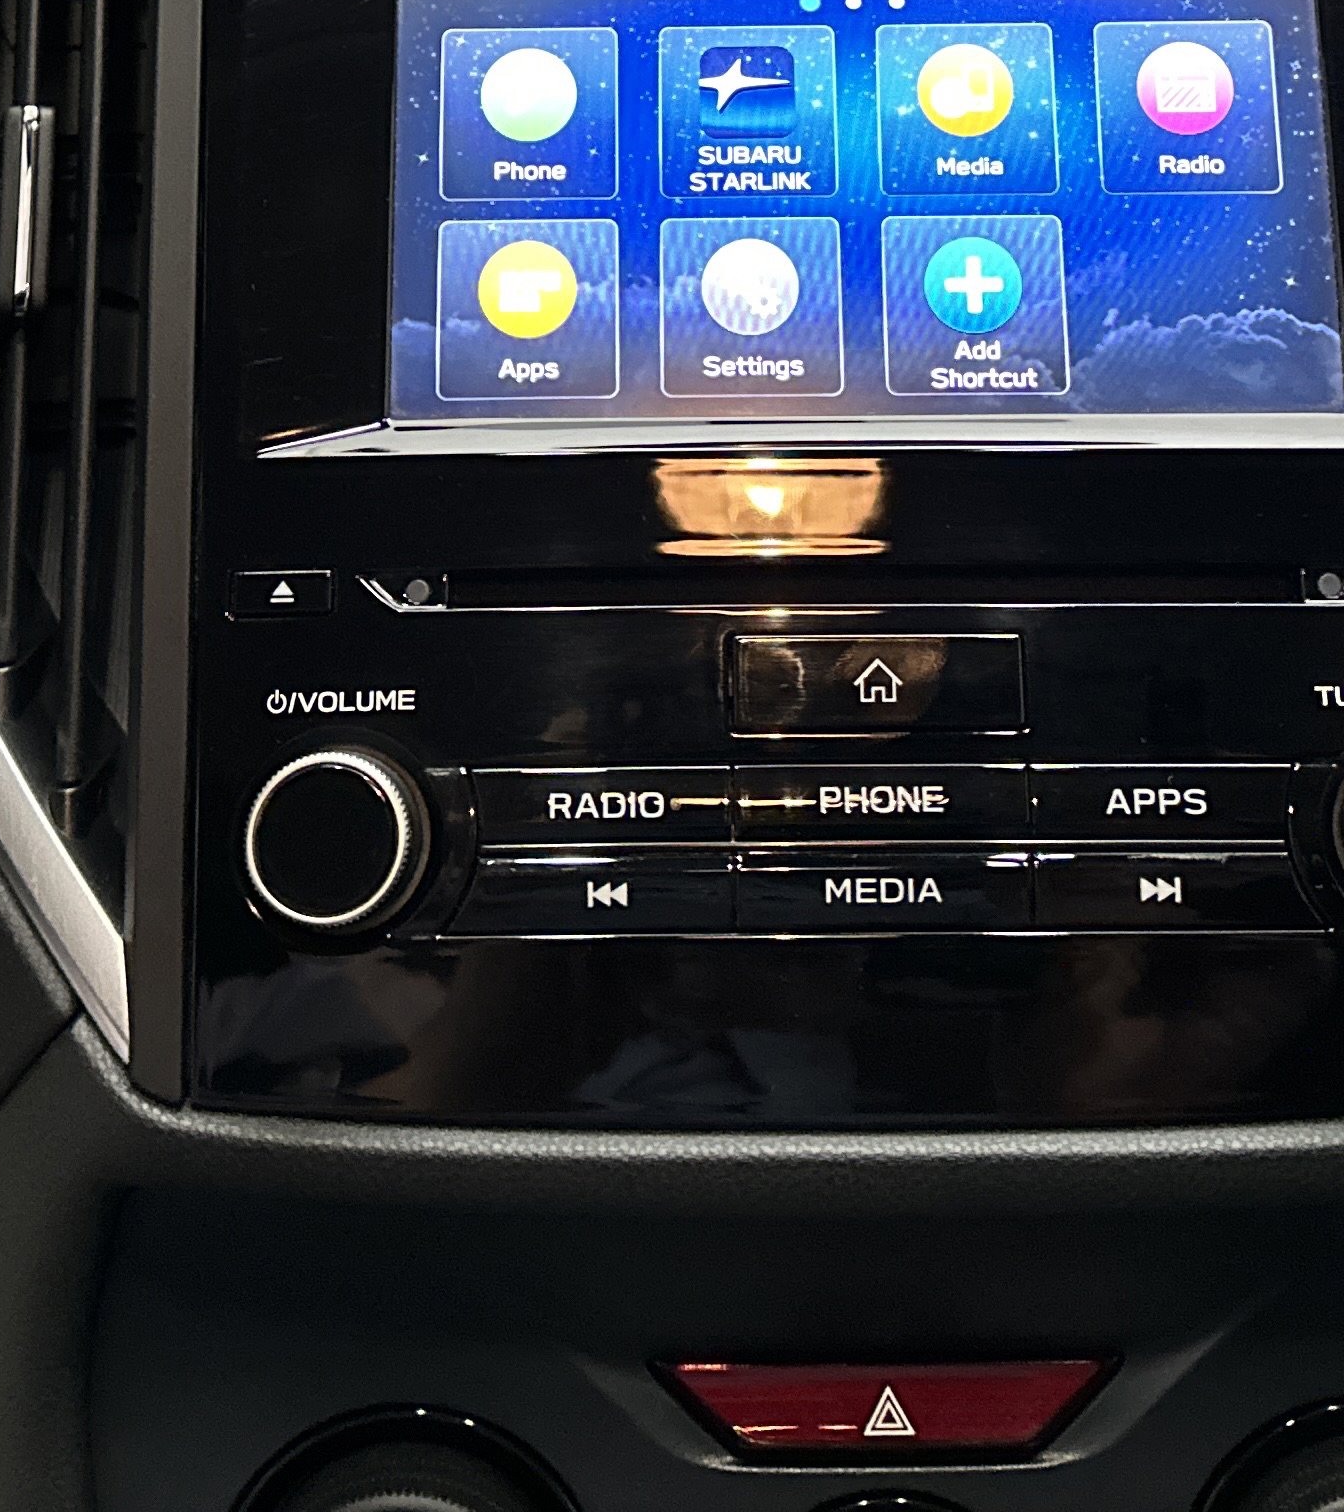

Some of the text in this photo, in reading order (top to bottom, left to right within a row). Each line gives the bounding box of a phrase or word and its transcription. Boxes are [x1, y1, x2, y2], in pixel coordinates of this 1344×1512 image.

[698, 145, 802, 166] SUBARU
[935, 156, 1004, 177] Media
[1158, 154, 1226, 176] Radio
[493, 161, 567, 182] Phone
[689, 171, 812, 193] STARLINK
[953, 340, 1002, 361] Add
[497, 358, 560, 383] Apps
[701, 355, 805, 381] Settings
[930, 367, 1038, 389] Shortcut
[547, 791, 665, 820] RADIO
[819, 785, 946, 815] PHONE
[1105, 787, 1208, 817] APPS
[824, 876, 944, 905] MEDIA
